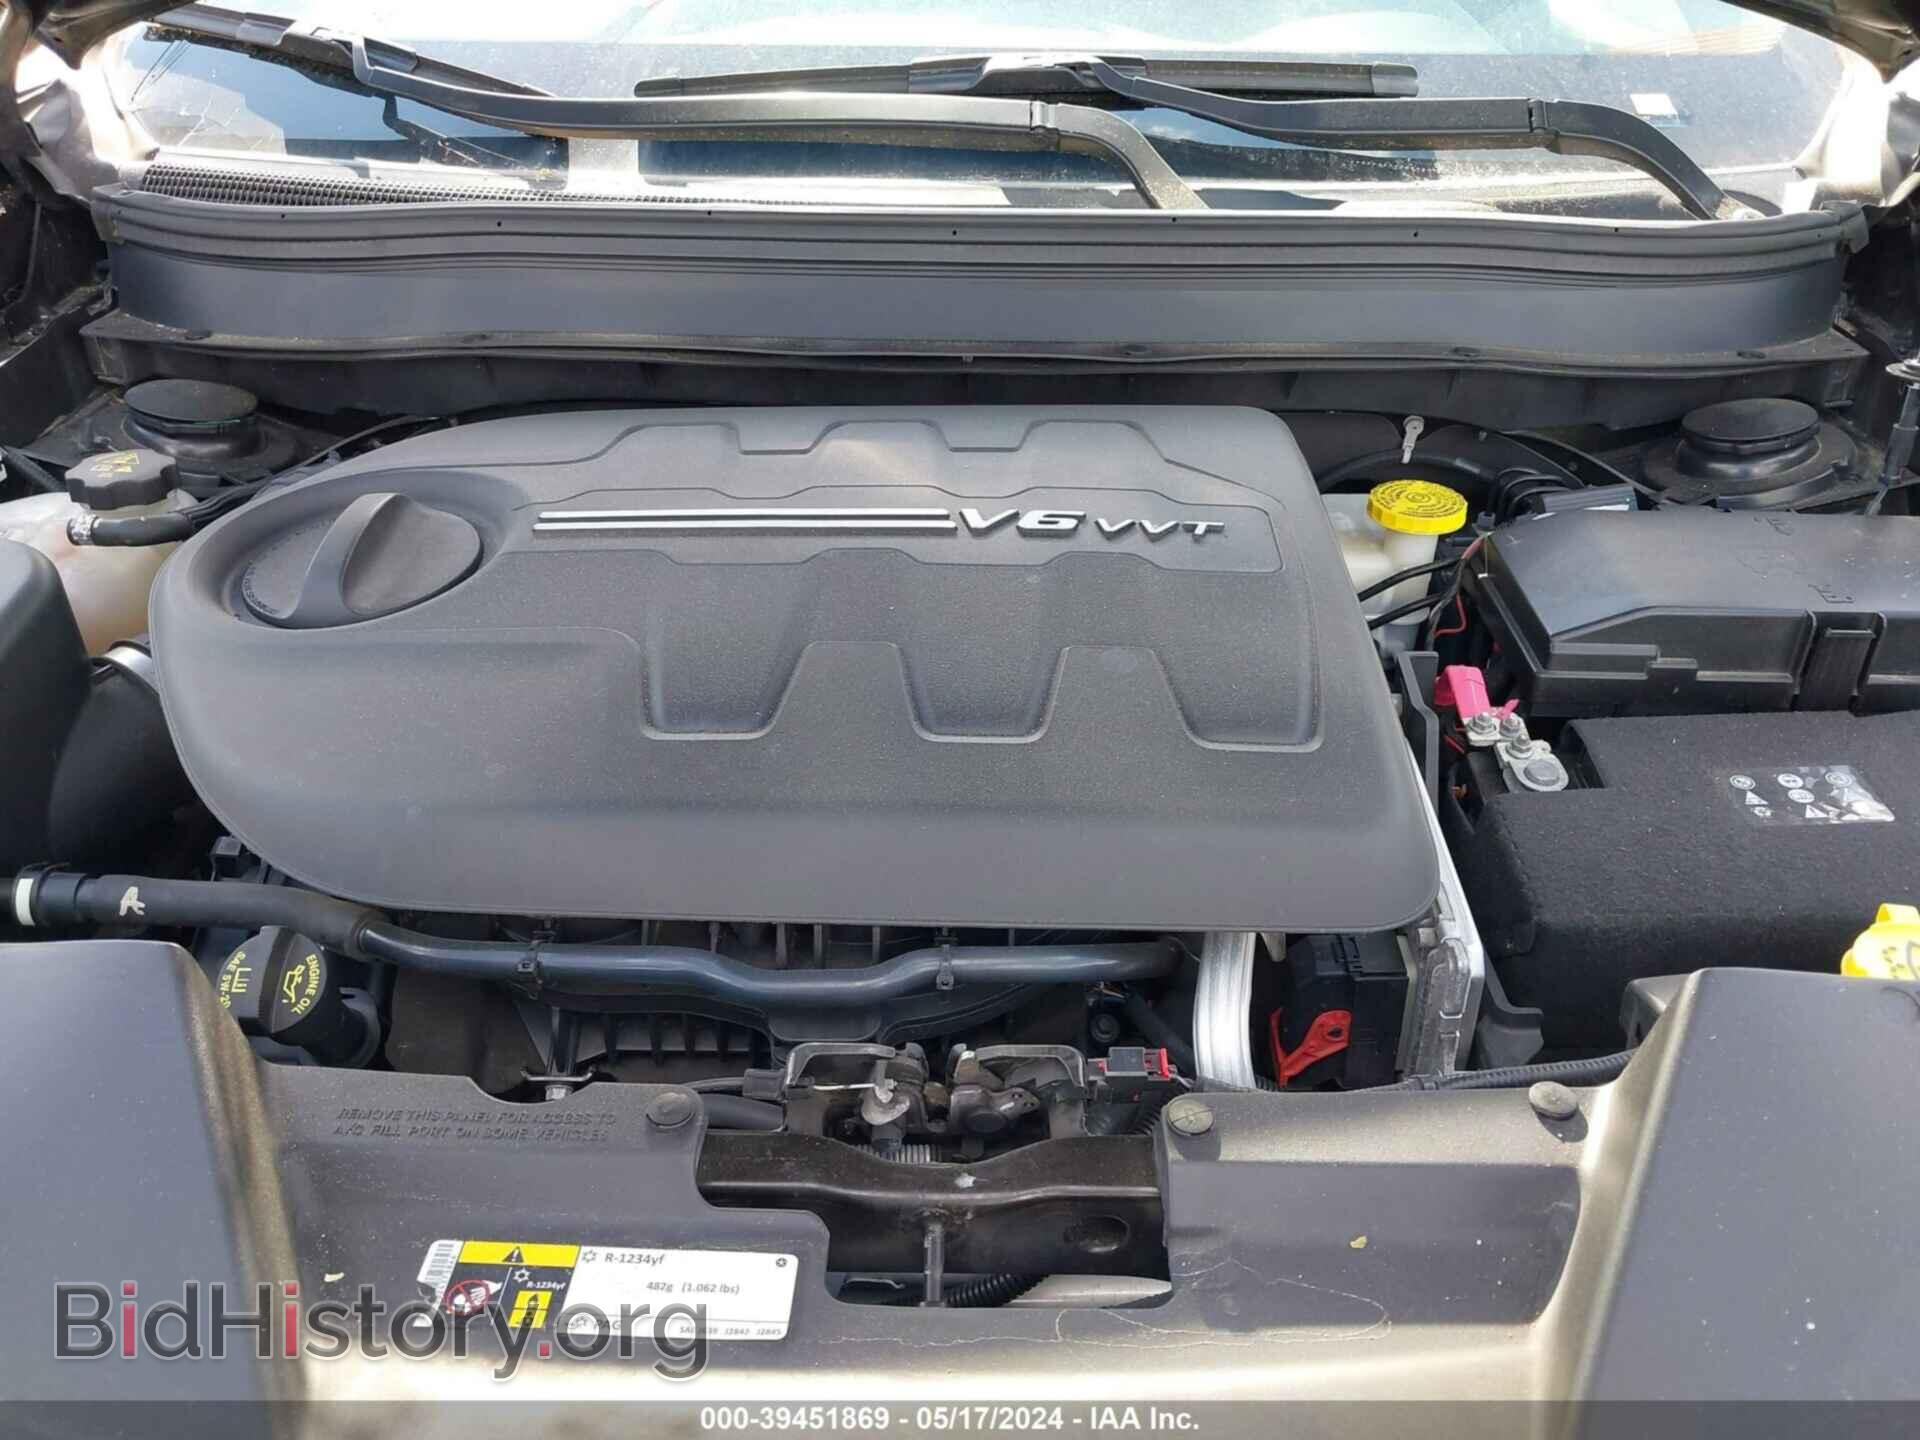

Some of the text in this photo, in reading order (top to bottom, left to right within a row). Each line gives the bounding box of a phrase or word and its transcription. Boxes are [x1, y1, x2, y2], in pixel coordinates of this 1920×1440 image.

[958, 508, 1225, 543] V6 VVT
[290, 954, 320, 1015] ENGINE OIL
[336, 1108, 402, 1121] REMOVE
[405, 1110, 442, 1122] THIS
[497, 1111, 529, 1124] FOR
[408, 1126, 448, 1138] PORT
[605, 1252, 665, 1266] R-1234yf
[526, 1281, 566, 1291] R-1234yf
[681, 1281, 716, 1294] (1.062
[719, 1282, 741, 1295] lbs)
